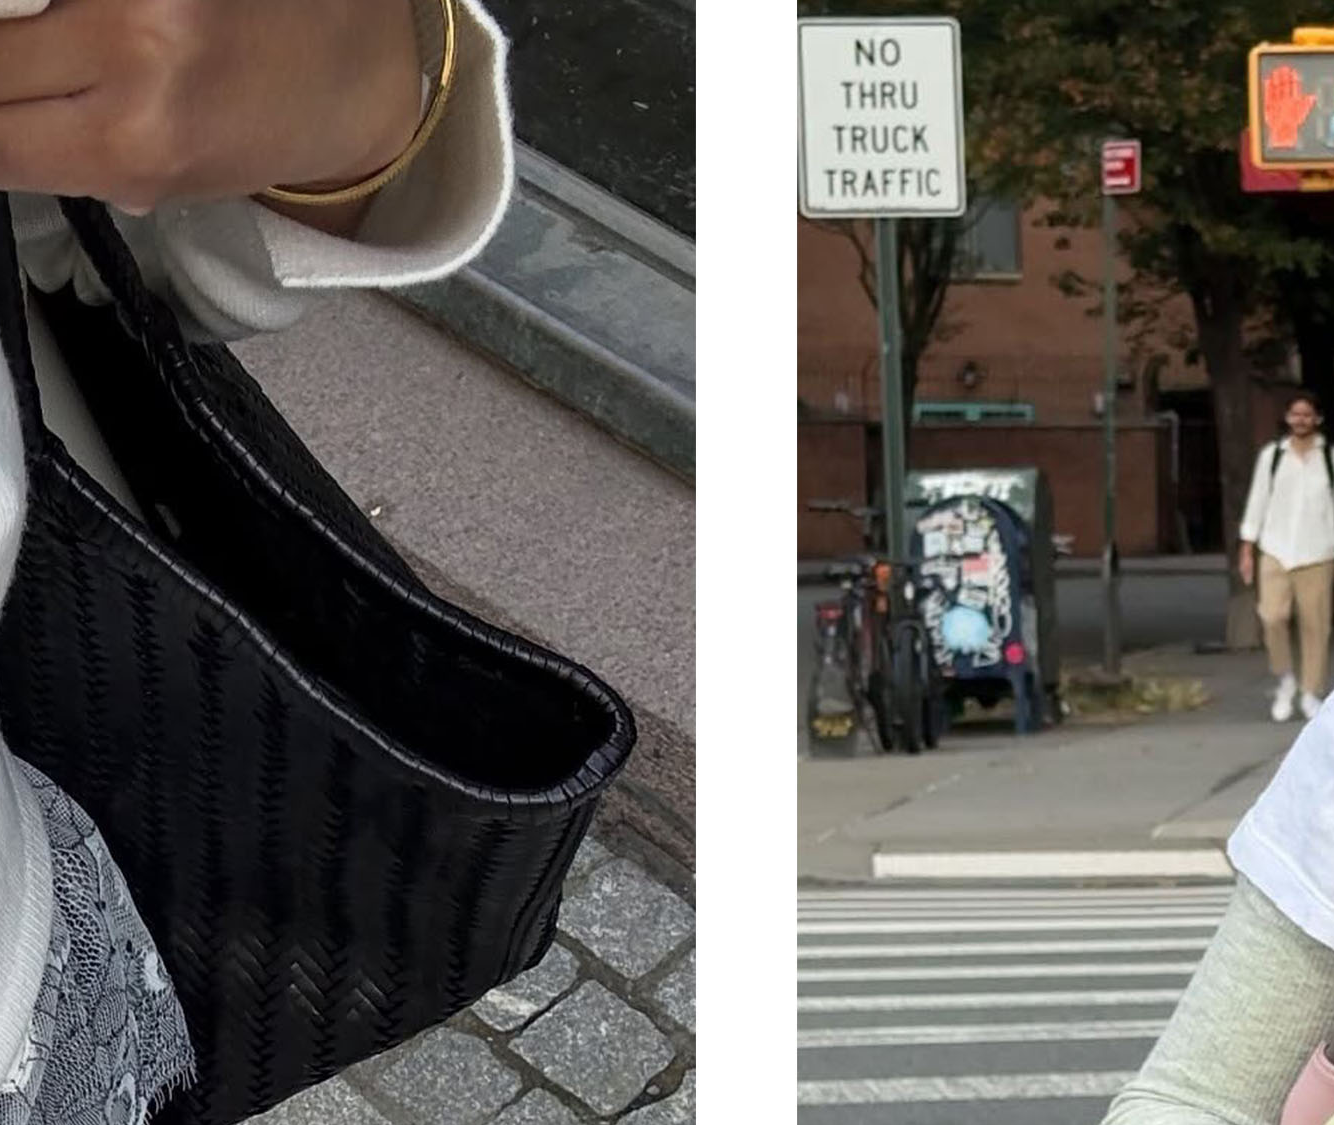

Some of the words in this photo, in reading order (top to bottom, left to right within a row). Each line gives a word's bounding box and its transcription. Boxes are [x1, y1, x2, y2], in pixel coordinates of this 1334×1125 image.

[855, 38, 901, 67] NO
[841, 81, 918, 110] THRU
[833, 125, 929, 154] TRUCK
[824, 168, 941, 198] TRAFFIC
